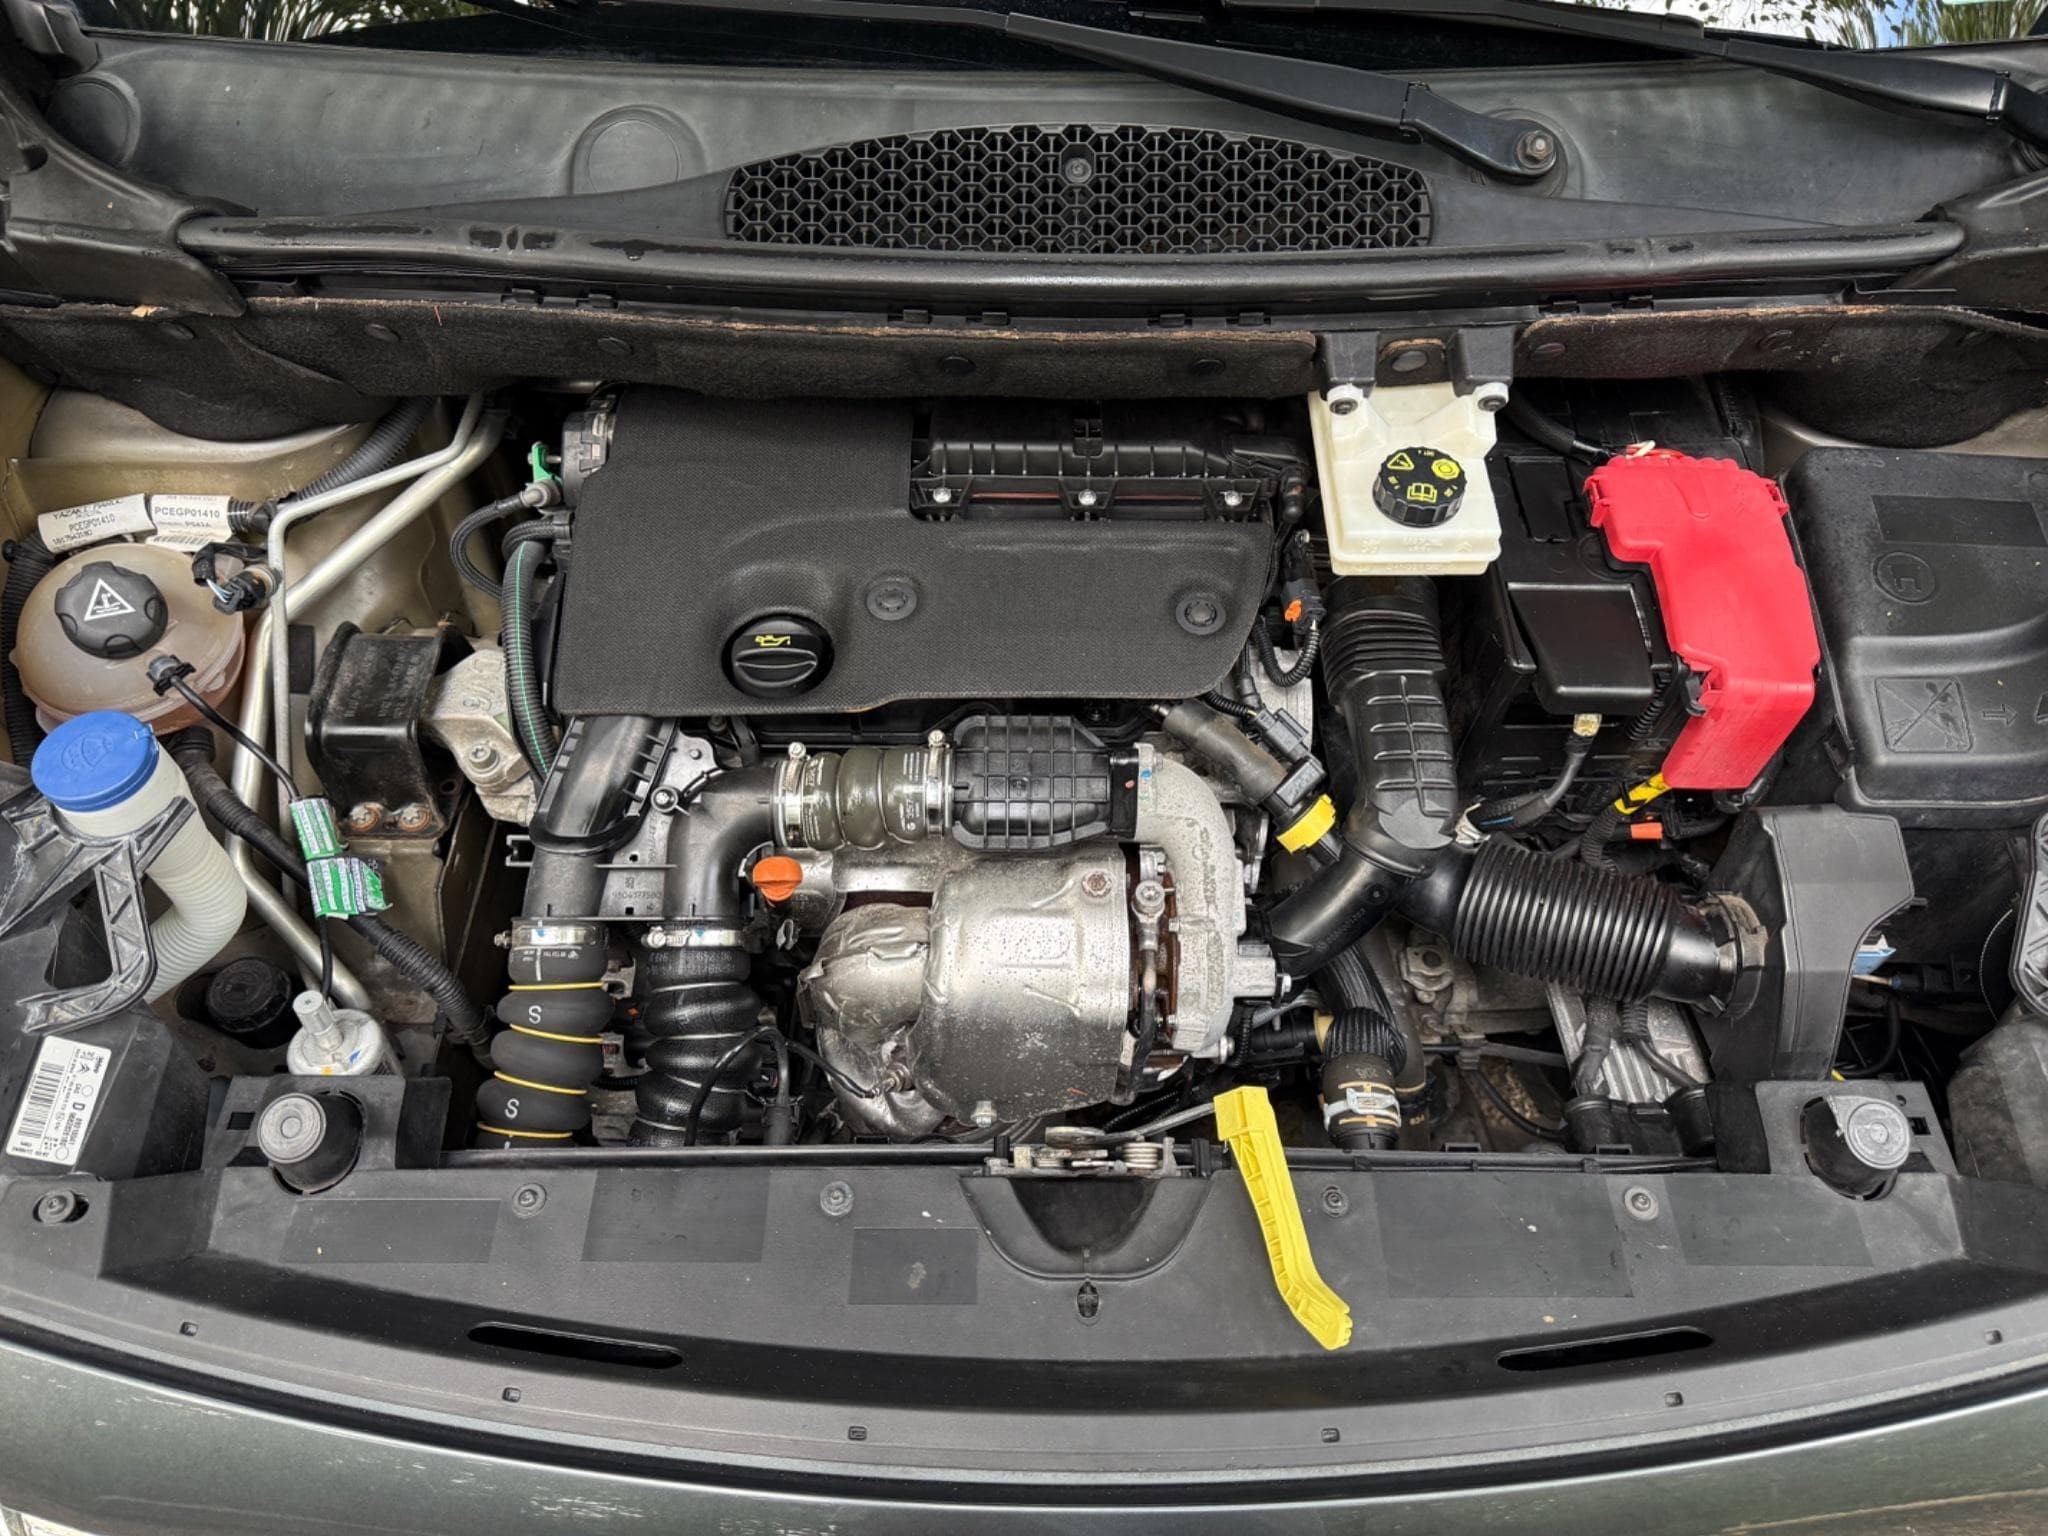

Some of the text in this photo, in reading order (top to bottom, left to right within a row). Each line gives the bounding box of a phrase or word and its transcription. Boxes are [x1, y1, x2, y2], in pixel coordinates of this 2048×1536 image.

[154, 505, 221, 519] PCEGP01410
[528, 1004, 542, 1025] S
[72, 1102, 85, 1112] D
[504, 1097, 520, 1119] S
